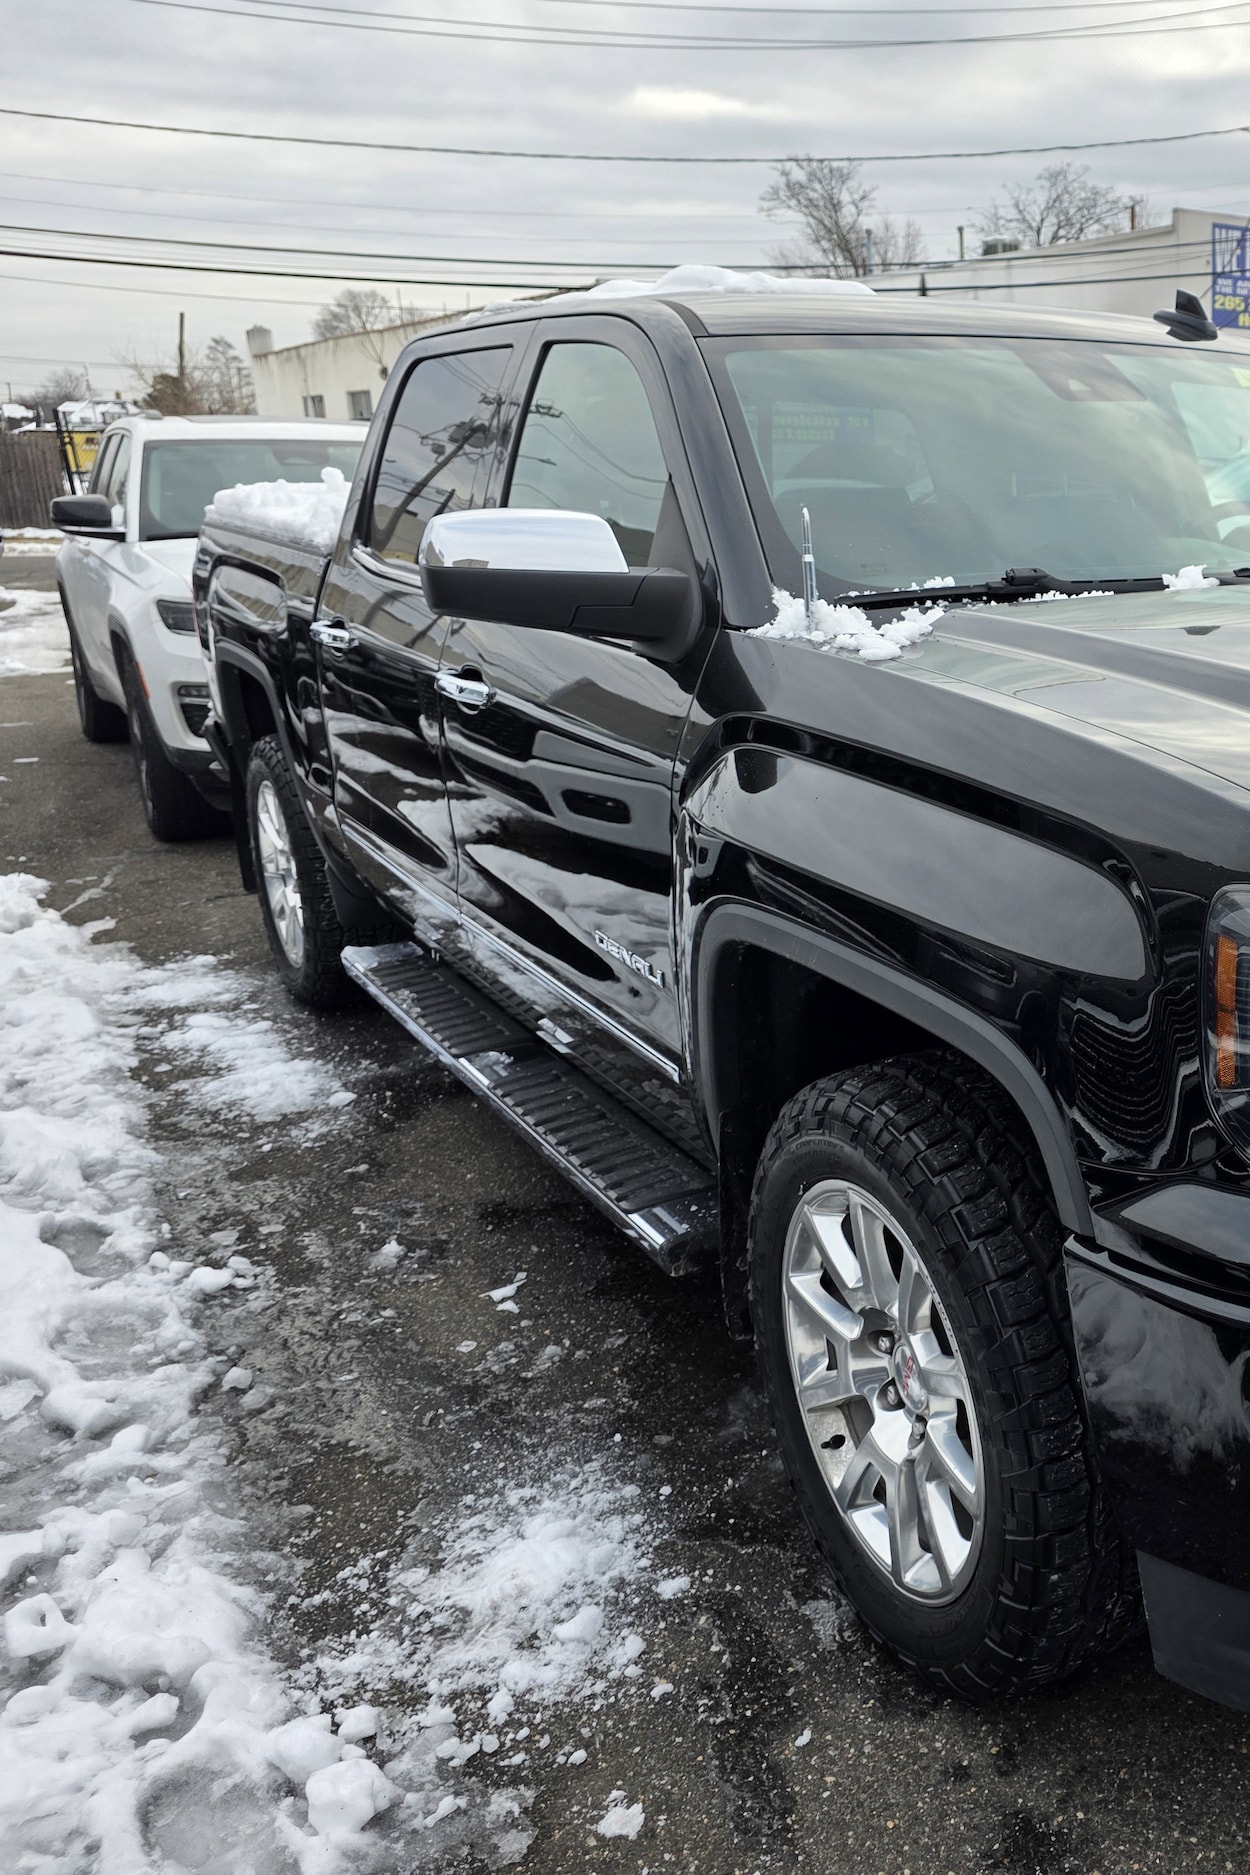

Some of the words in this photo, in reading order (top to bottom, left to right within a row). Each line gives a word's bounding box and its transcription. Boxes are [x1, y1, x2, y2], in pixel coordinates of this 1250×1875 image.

[1214, 294, 1246, 311] 265
[594, 929, 666, 989] DENALI
[902, 1355, 915, 1394] GMC
